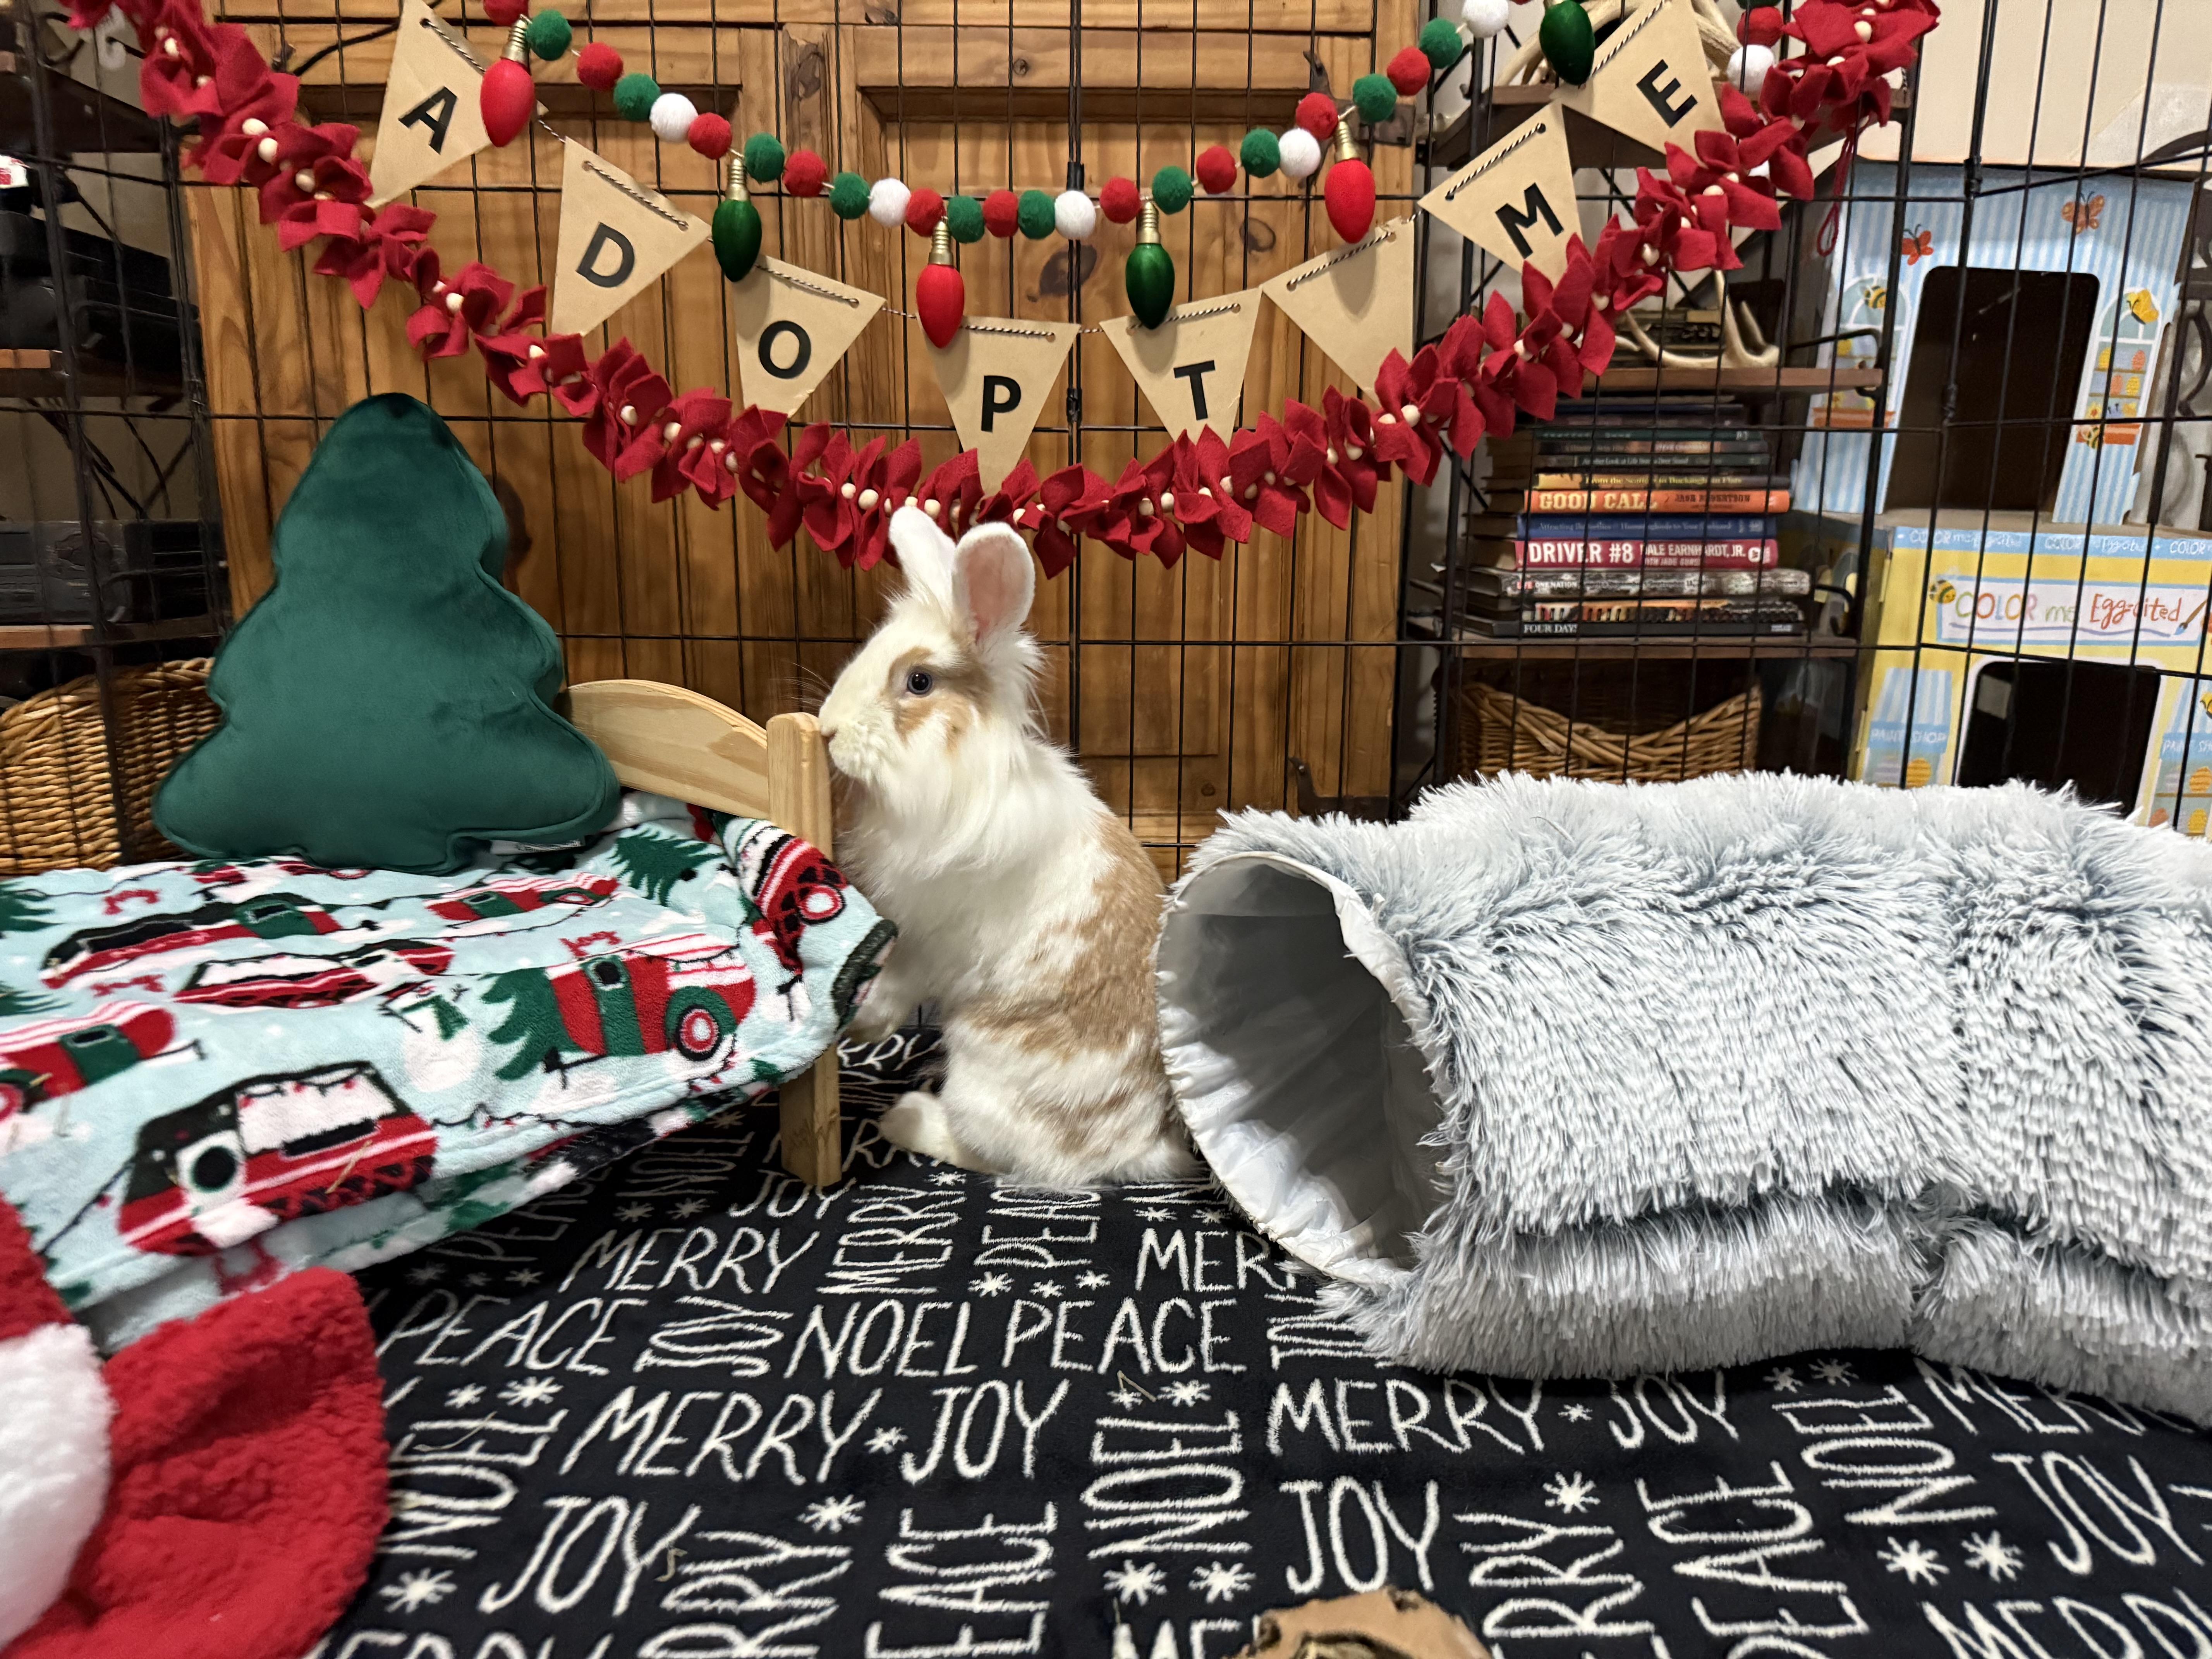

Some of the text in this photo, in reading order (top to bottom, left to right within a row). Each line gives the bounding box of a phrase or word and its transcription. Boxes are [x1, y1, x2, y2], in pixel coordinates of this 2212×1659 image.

[1539, 492, 1597, 510] GOOD
[1528, 543, 1633, 563] DRIVER #8
[1955, 591, 2038, 621] COLOR
[559, 1226, 819, 1295] MERRY
[1135, 1228, 1296, 1292] MER
[376, 1290, 649, 1376] PEACE
[784, 1298, 979, 1379] NOEL
[1001, 1297, 1247, 1375] PEACE
[559, 1386, 884, 1486] MERRY
[900, 1379, 1070, 1485] JOY
[1267, 1377, 1544, 1455] MERRY
[1609, 1369, 1740, 1449] JOY
[1080, 1408, 1252, 1559] NOEL
[1771, 1383, 1997, 1526] NOEL
[1280, 1475, 1441, 1594] JOY
[1992, 1450, 2205, 1575] JOY
[477, 1495, 701, 1617] JOY
